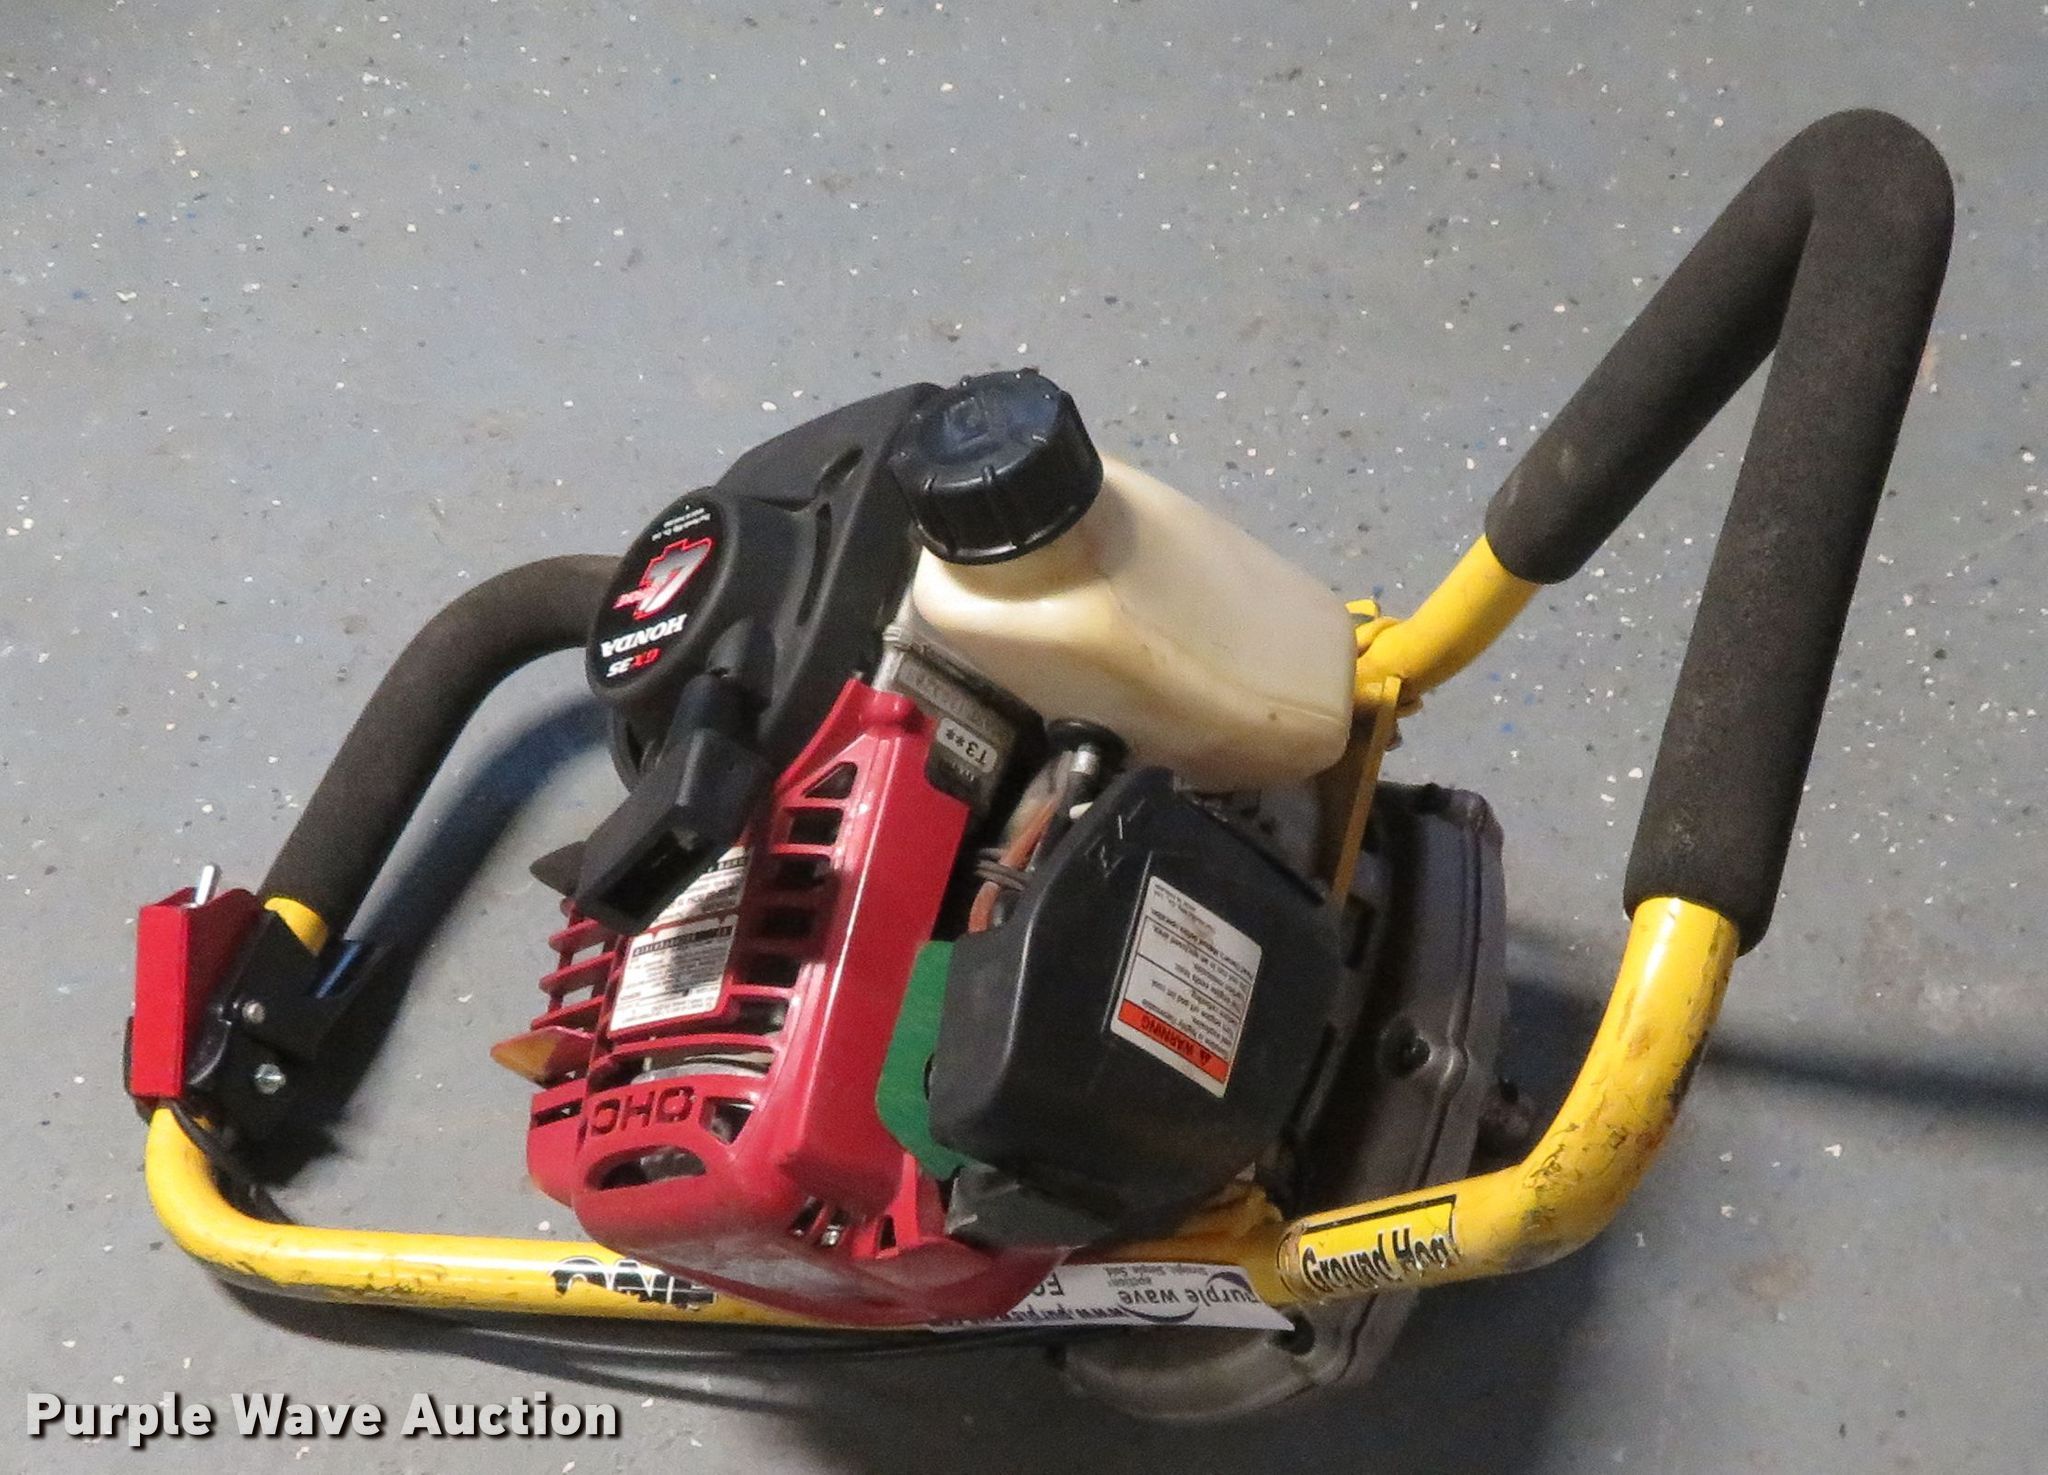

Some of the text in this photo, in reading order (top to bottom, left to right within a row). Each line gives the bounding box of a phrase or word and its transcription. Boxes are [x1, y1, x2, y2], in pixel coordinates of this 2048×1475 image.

[600, 613, 688, 658] HONDA
[1139, 1013, 1194, 1057] WARNING
[1302, 1233, 1402, 1292] Ground
[1118, 1288, 1181, 1306] wave
